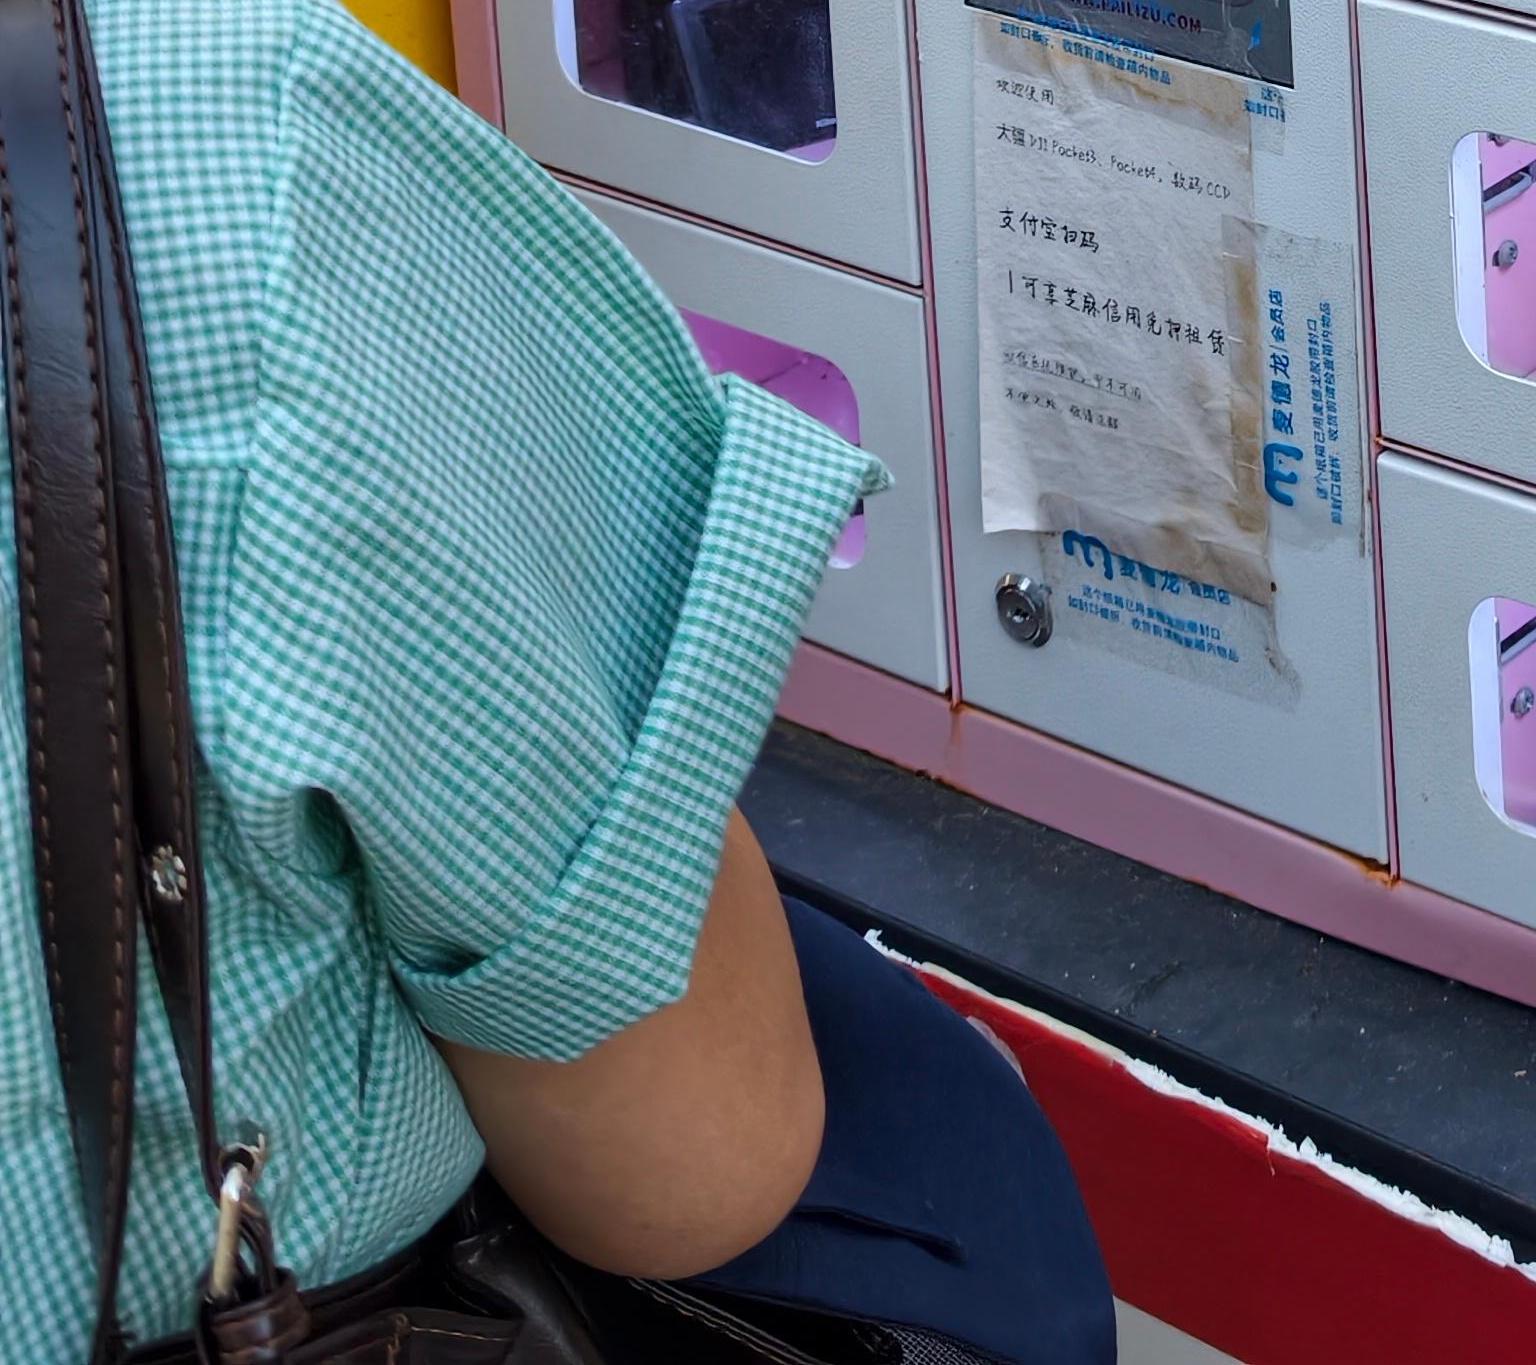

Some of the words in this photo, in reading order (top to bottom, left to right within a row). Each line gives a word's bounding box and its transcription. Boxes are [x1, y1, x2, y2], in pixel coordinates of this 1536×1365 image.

[996, 79, 1055, 106] 欢迎使用
[999, 206, 1100, 253] 支付宝扫码
